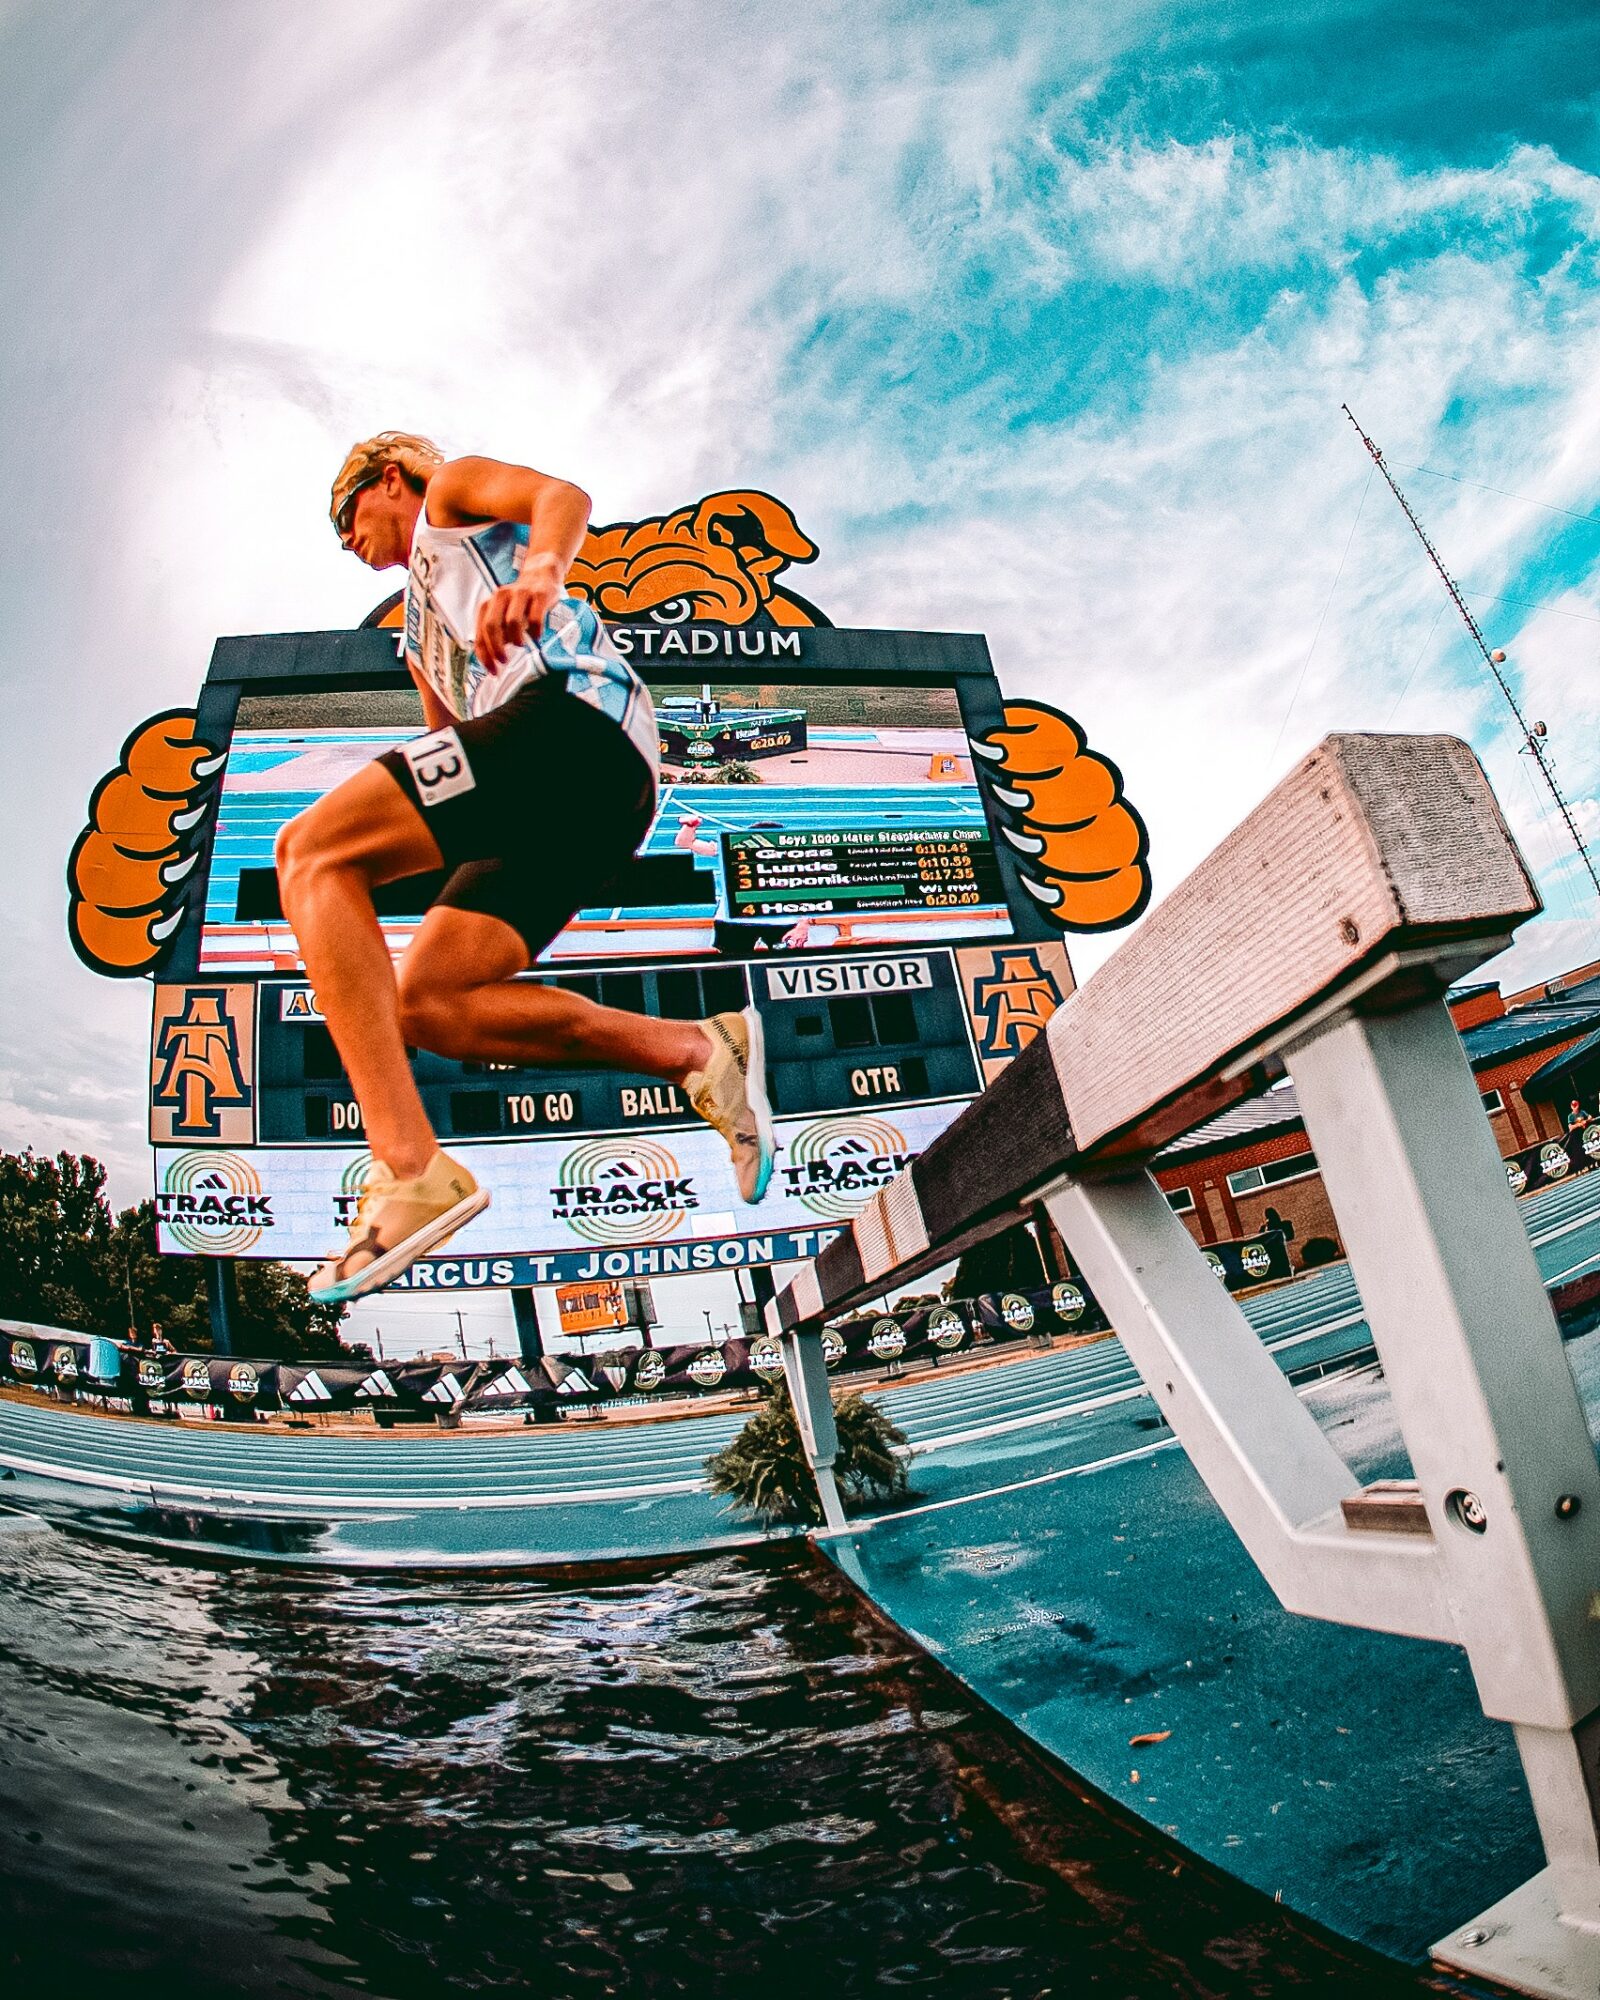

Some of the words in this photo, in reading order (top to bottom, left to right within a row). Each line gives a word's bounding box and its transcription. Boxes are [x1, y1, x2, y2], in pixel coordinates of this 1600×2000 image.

[613, 629, 801, 656] STADIUM
[412, 740, 462, 788] 13
[737, 850, 748, 860] 1
[739, 864, 752, 876] 2
[739, 878, 752, 889] 3
[741, 903, 756, 916] 4
[777, 961, 923, 994] VISITOR
[851, 1065, 901, 1095] QTR
[507, 1093, 535, 1124] TO
[544, 1092, 573, 1122] GO
[620, 1085, 684, 1117] BALL
[156, 1194, 274, 1214] TRACK
[550, 1178, 698, 1206] TRACK
[156, 1213, 275, 1227] NATIONALS
[552, 1198, 700, 1219] NATIONALS
[529, 1256, 561, 1282] T.
[577, 1237, 774, 1280] JOHNSON
